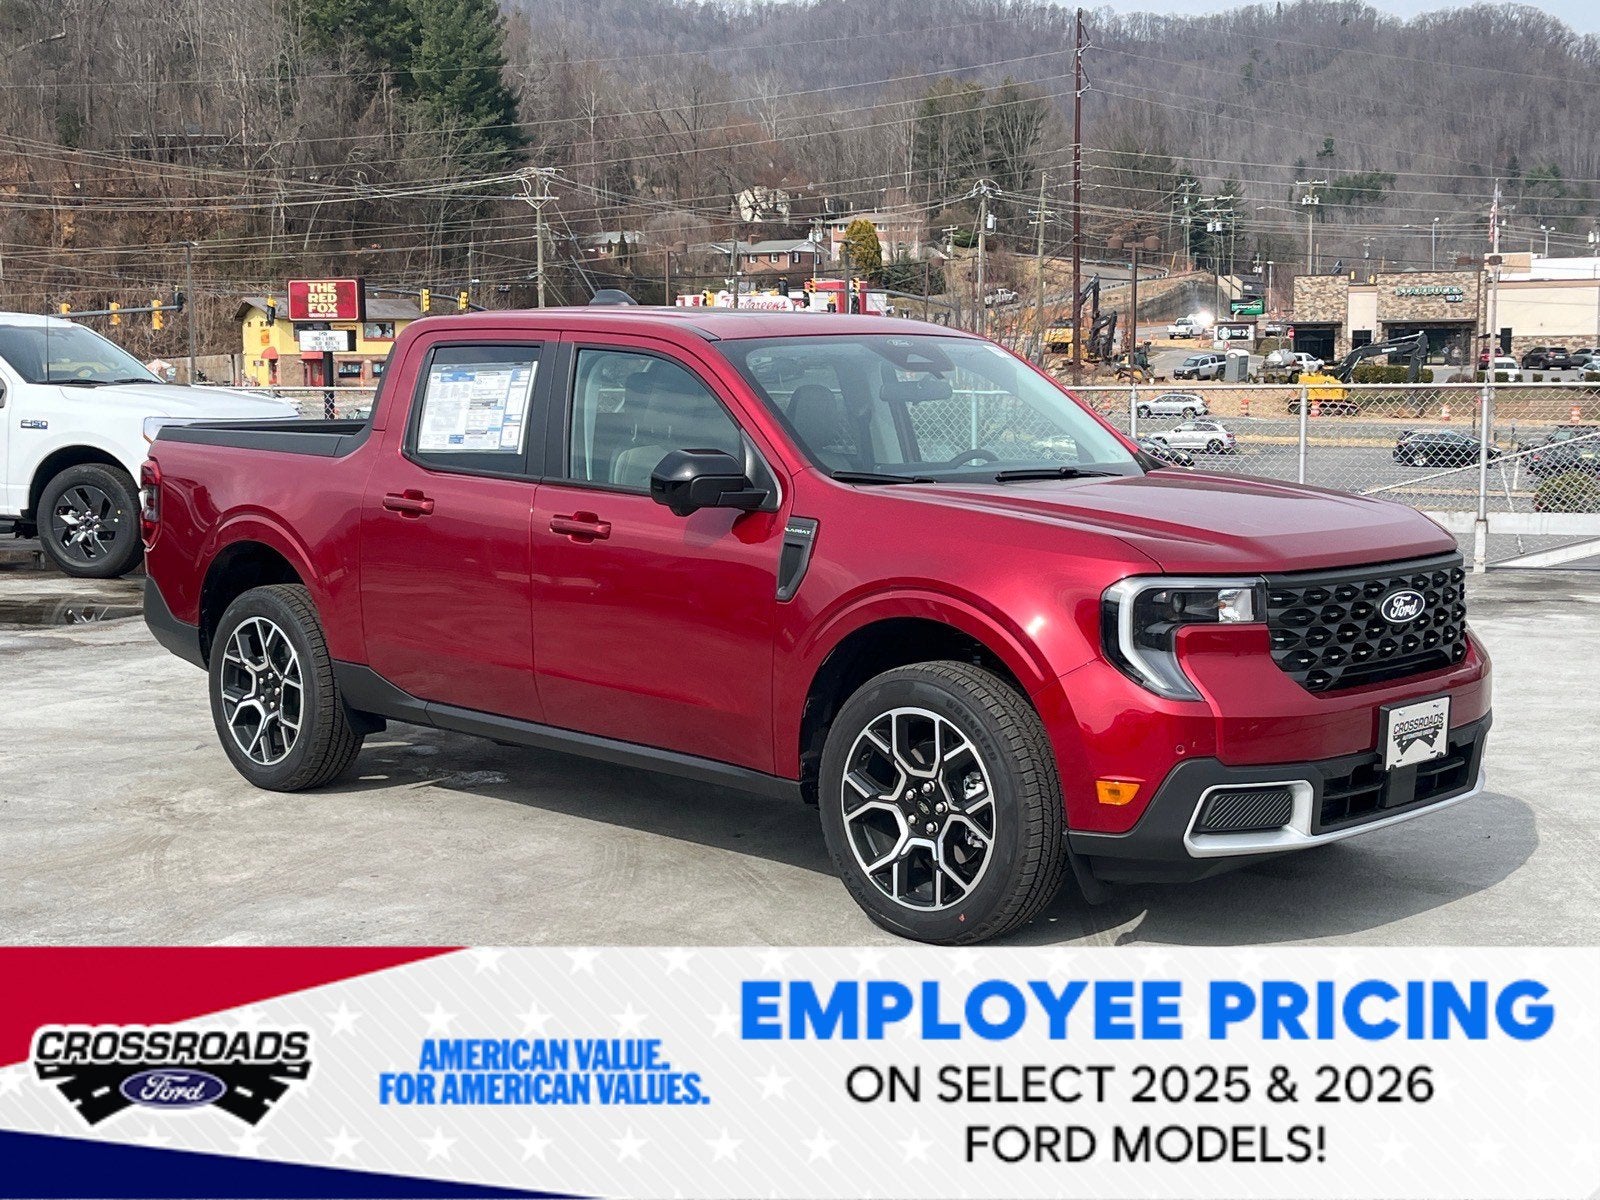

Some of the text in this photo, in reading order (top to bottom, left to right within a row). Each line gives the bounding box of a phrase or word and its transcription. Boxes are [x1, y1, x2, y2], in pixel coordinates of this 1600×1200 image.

[308, 283, 337, 293] THE
[1395, 286, 1463, 296] STARBUCKS
[308, 293, 338, 303] RED
[308, 303, 338, 313] FOX
[1390, 595, 1418, 618] Ford
[1393, 712, 1444, 735] CROSSROADS
